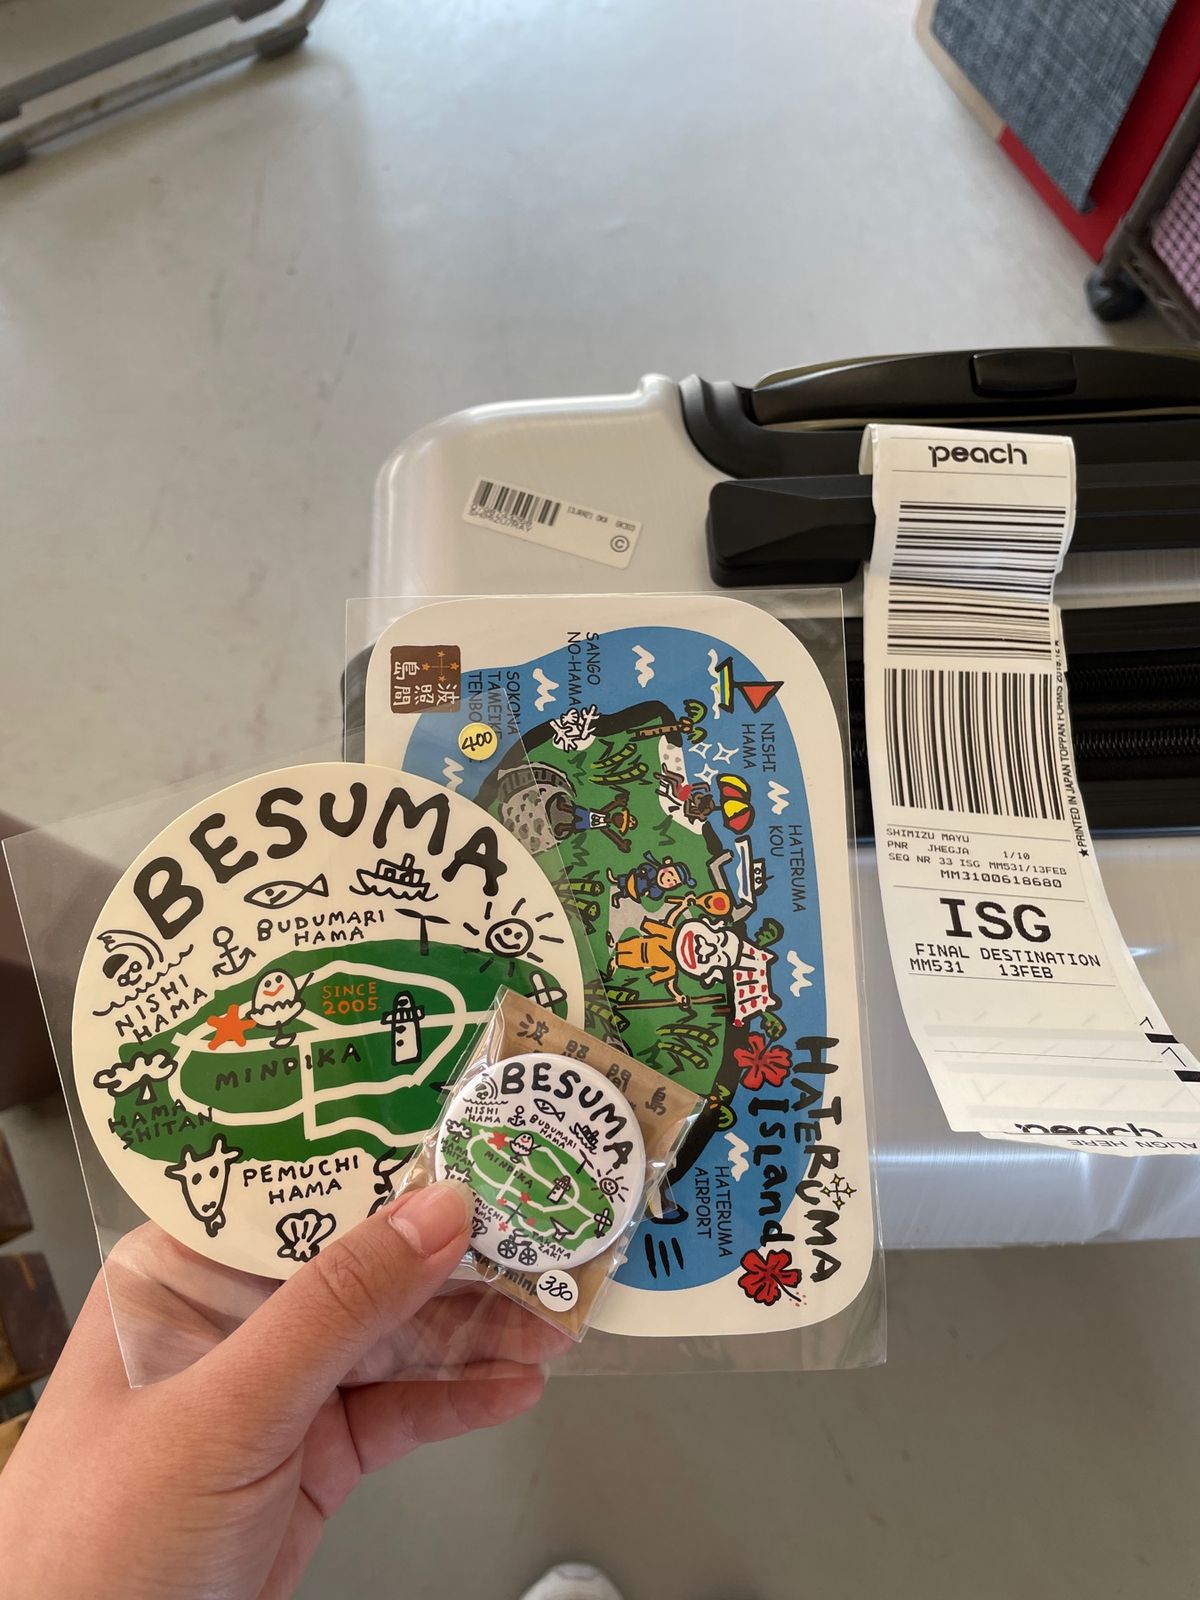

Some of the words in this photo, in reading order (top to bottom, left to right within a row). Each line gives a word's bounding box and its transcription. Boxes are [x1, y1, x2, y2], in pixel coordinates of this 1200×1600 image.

[928, 444, 1028, 468] peach
[393, 661, 420, 680] 島
[567, 632, 582, 706] NO-HAMA
[586, 631, 600, 686] SANGO
[393, 683, 460, 706] 波照間
[506, 671, 521, 736] SOKONA
[461, 731, 493, 752] 400
[741, 724, 757, 770] HAMA
[760, 722, 776, 772] NISHI
[1058, 723, 1070, 762] TOPPAN
[1062, 764, 1076, 794] JAPAN
[1068, 796, 1078, 806] IN
[768, 825, 784, 857] KOU
[886, 828, 935, 840] SHIMIZU
[941, 833, 970, 843] MAYU
[1070, 807, 1087, 848] PRINTED
[133, 782, 508, 940] BESUMA
[887, 840, 908, 850] PNR
[1002, 850, 1030, 860] 1/10
[888, 852, 910, 862] SEQ
[916, 856, 931, 864] NR
[939, 857, 952, 866] 33
[960, 859, 980, 868] ISG
[989, 862, 1068, 876] MM531/13FEB
[788, 825, 806, 913] HATERUMA
[940, 869, 1062, 888] MM3100618680
[257, 910, 386, 942] BUDUMARI
[294, 926, 364, 946] HAMA
[940, 898, 1052, 943] ISG
[910, 958, 964, 974] MM531
[1000, 964, 1053, 979] 13FEB
[916, 943, 970, 959] FINAL
[980, 948, 1101, 967] DESTINATION
[115, 974, 188, 1037] NISHI
[322, 982, 378, 999] SINCE
[322, 996, 379, 1016] 2005
[133, 988, 208, 1045] HAMA
[215, 1043, 361, 1091] MINPIKA
[108, 1098, 187, 1134] HAMA
[464, 1106, 499, 1115] NISHI
[468, 1114, 501, 1124] HAMA
[500, 1062, 634, 1170] BESUMA
[120, 1106, 212, 1150] SHITAN
[529, 1114, 577, 1150] BUDUMARI
[540, 1128, 566, 1150] HAMA
[1067, 1138, 1128, 1148] HERE
[790, 1036, 842, 1283] HATERUMA
[1135, 1141, 1198, 1150] ALIGN
[242, 1154, 360, 1188] PEMUCHI
[268, 1178, 342, 1204] HAMA
[694, 1168, 712, 1239] AIRPORT
[714, 1166, 734, 1258] HATERUMA
[538, 1275, 574, 1302] 380
